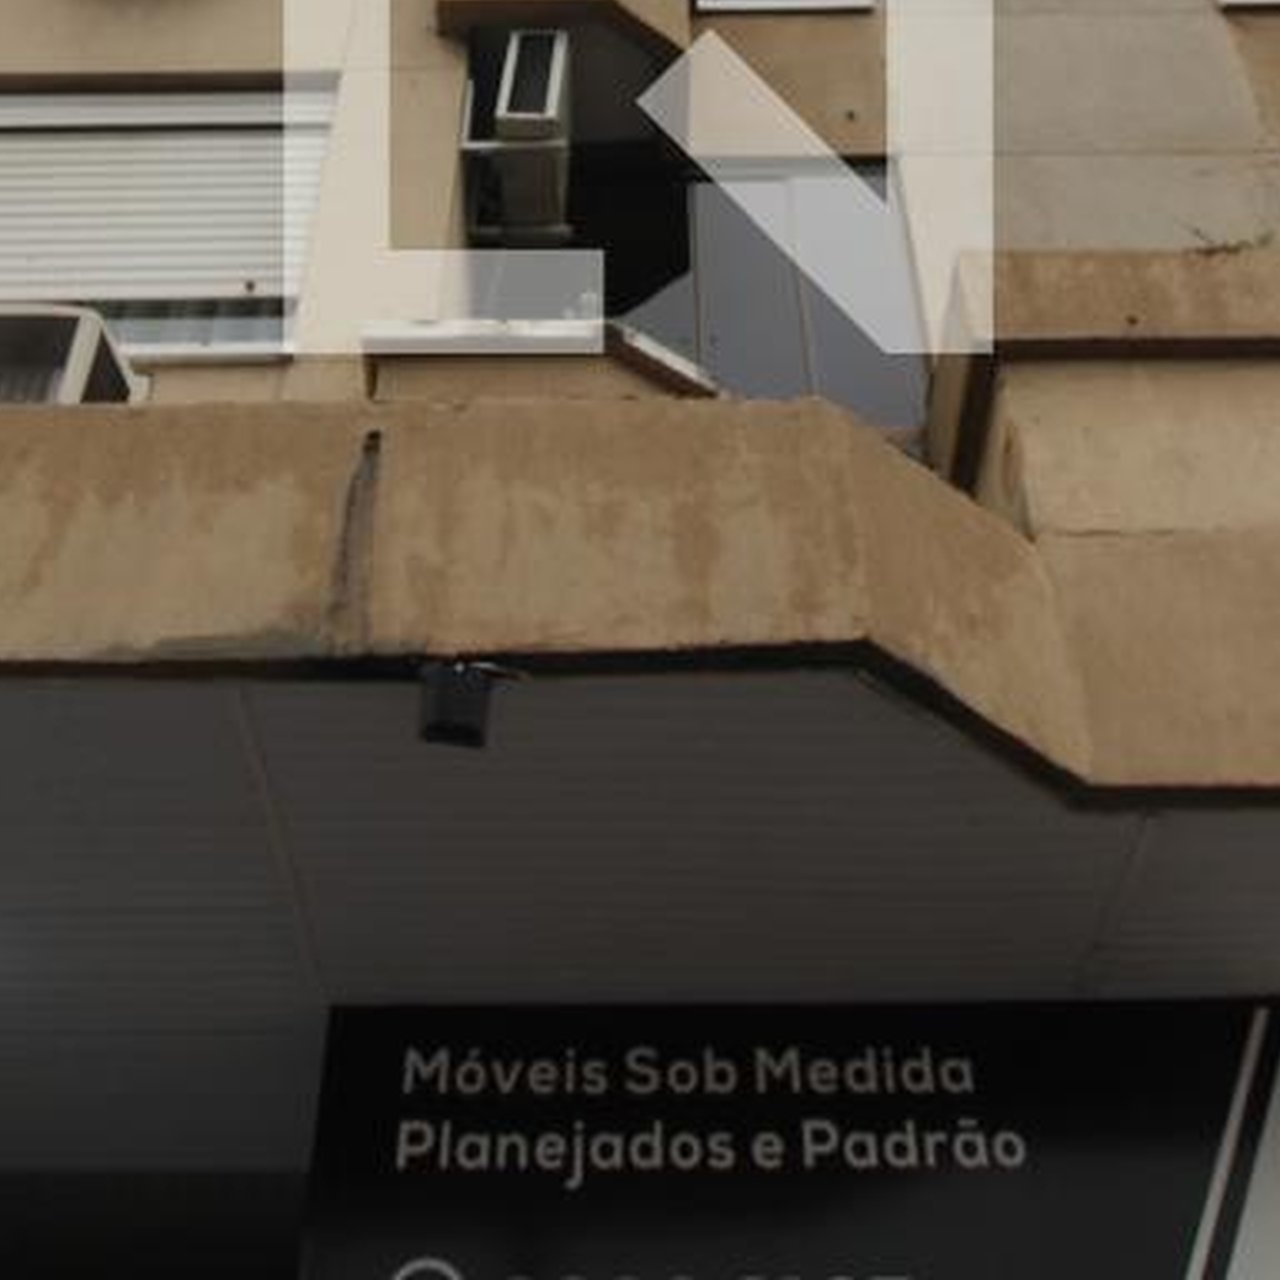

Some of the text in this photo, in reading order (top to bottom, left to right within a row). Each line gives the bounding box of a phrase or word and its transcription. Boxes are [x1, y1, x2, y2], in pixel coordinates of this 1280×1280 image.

[401, 1045, 977, 1096] Móveis Sob Medida
[393, 1117, 1027, 1190] Planejados e Padrão
